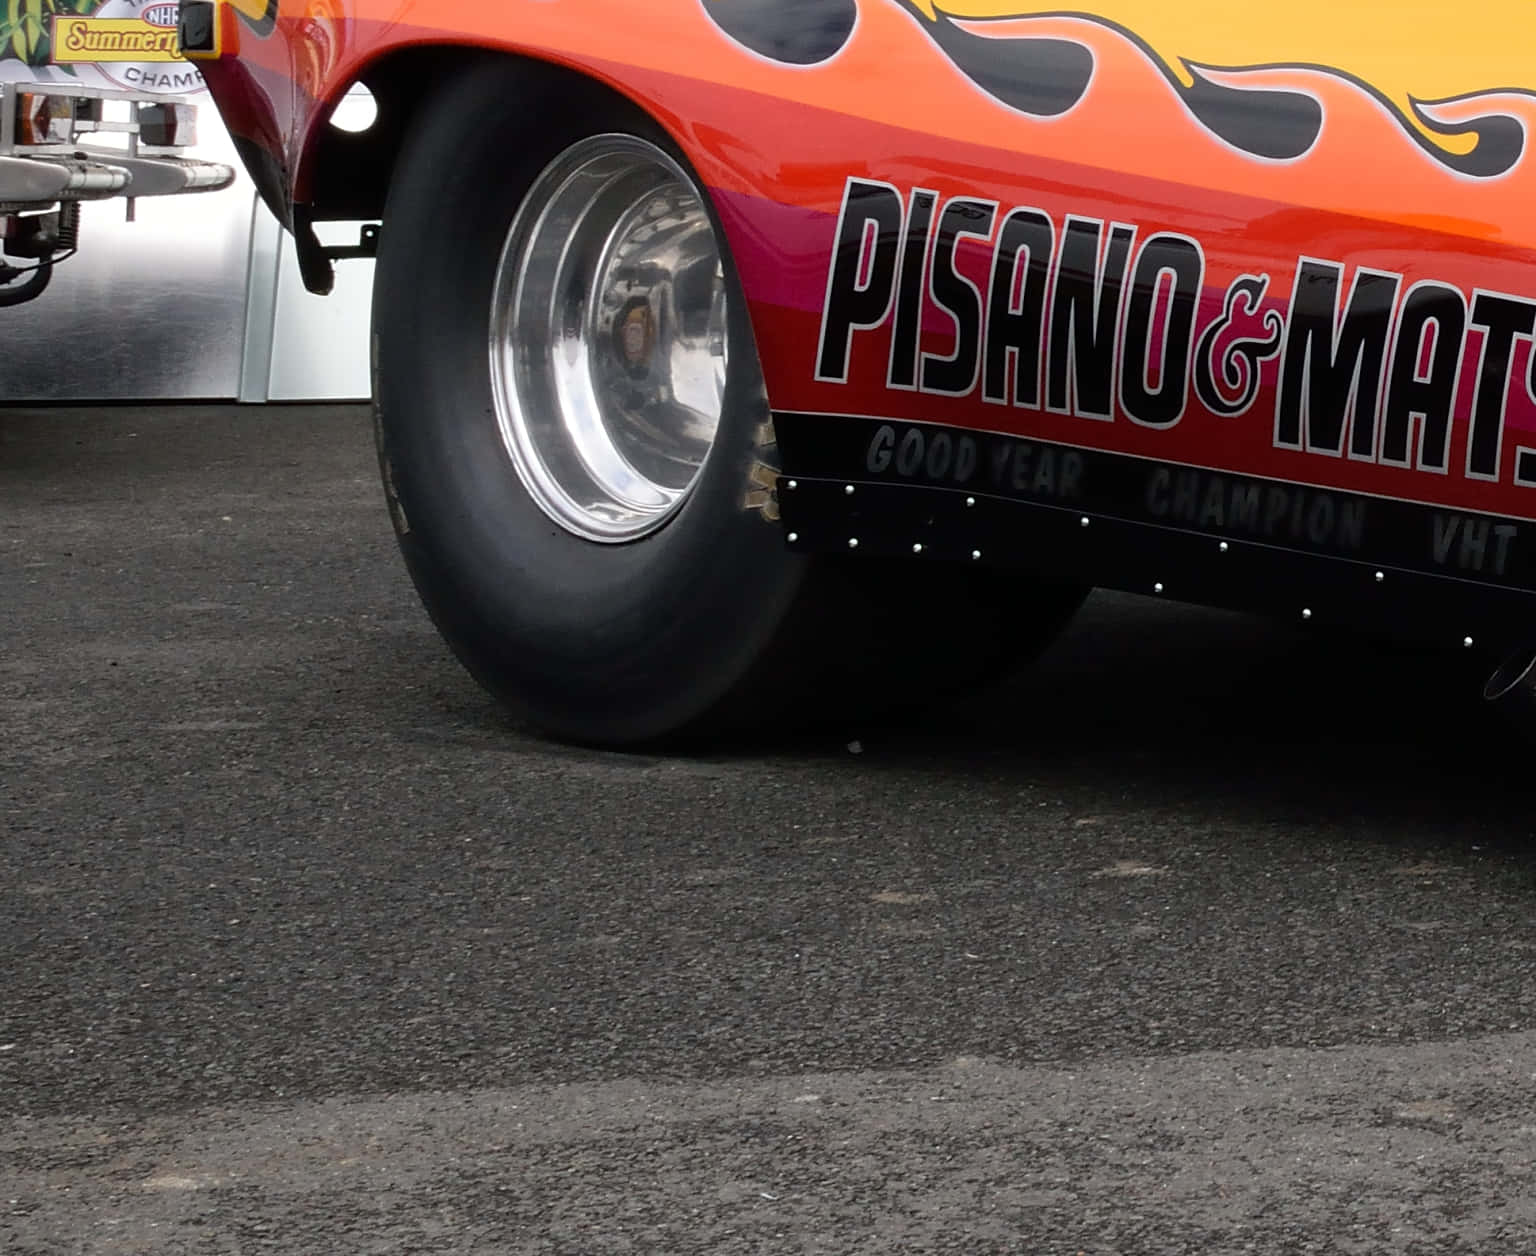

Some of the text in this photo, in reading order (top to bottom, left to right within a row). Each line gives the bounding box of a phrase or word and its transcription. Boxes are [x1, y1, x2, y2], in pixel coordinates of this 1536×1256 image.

[814, 176, 1206, 429] PISANO
[1145, 468, 1368, 546] CHAMPION
[1432, 514, 1518, 576] VHT
